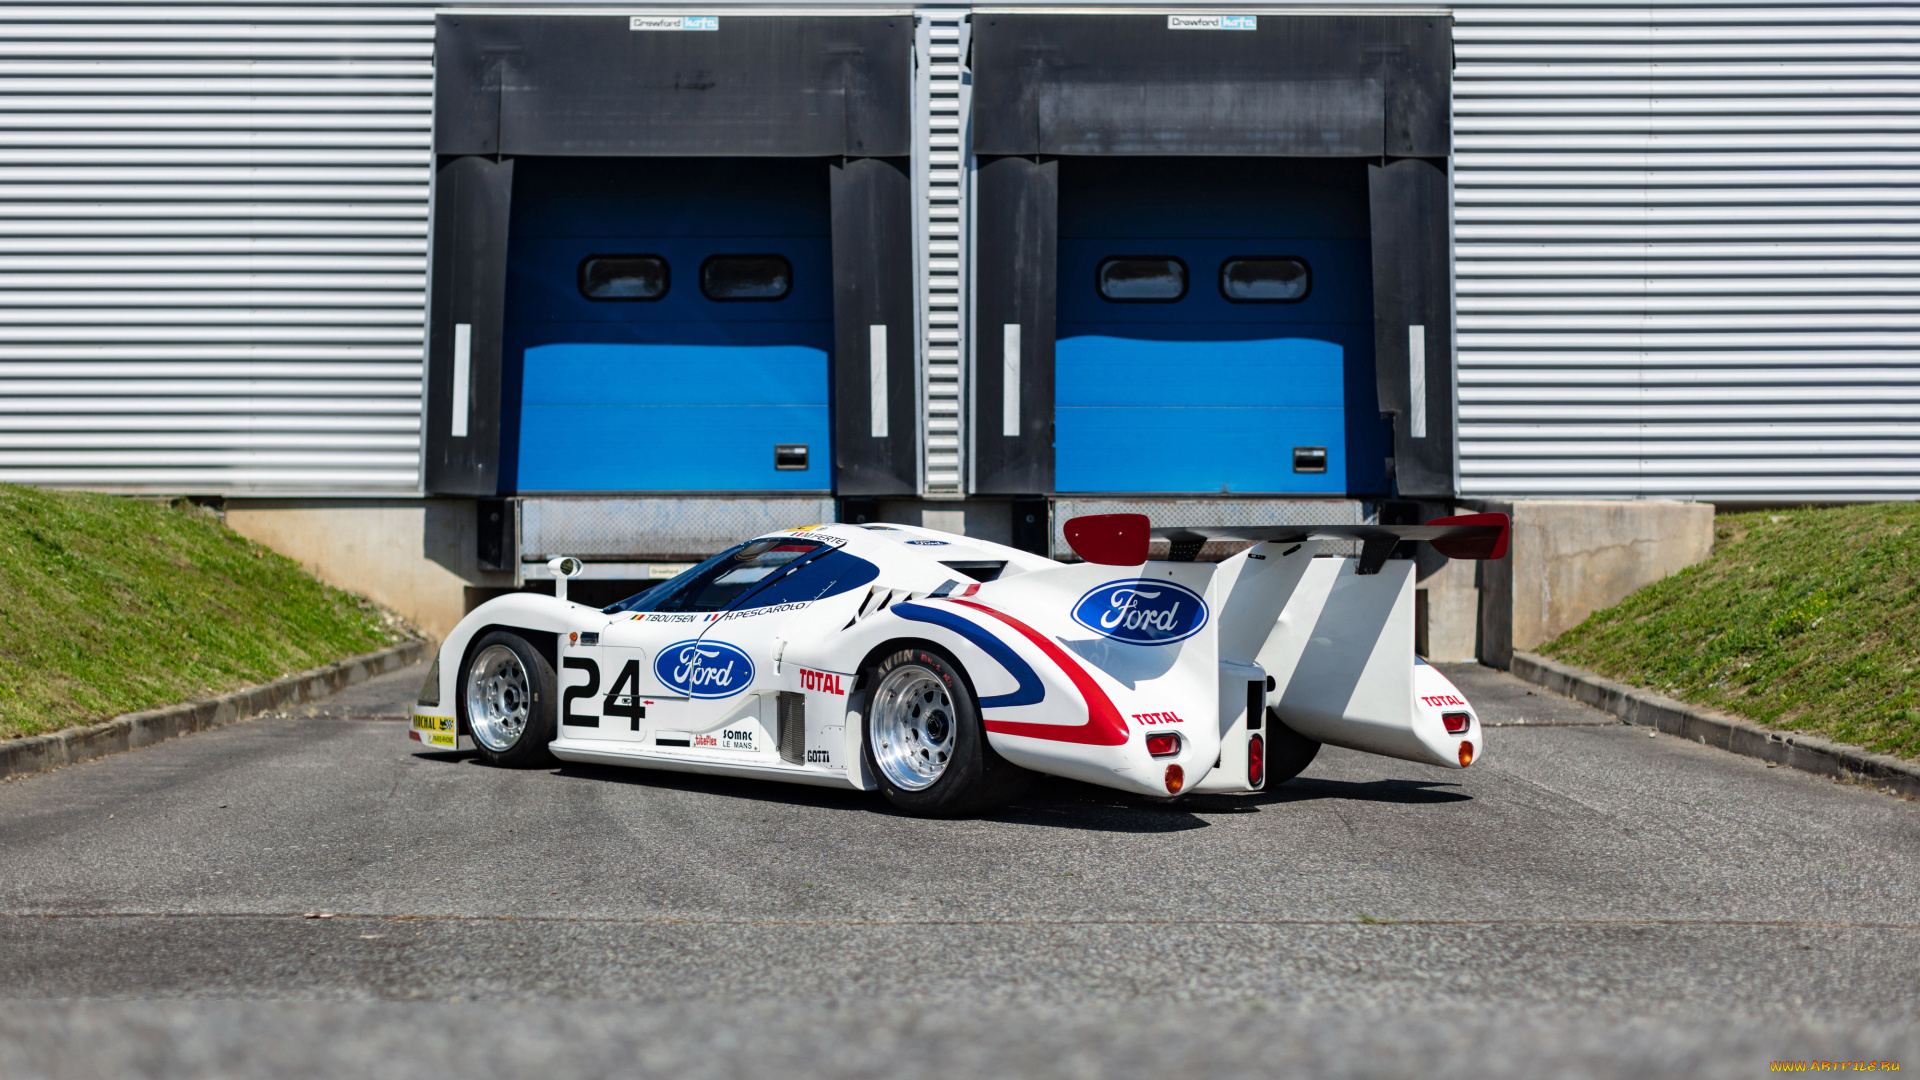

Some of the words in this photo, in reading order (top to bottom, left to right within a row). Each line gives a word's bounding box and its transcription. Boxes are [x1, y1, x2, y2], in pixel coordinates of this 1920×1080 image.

[1172, 17, 1219, 26] Crawford
[724, 602, 805, 621] H.PESCAROLO
[1100, 588, 1181, 631] Ford
[645, 614, 697, 623] T.BOUTSEN
[673, 646, 734, 687] Ford
[799, 668, 845, 696] TOTAL
[562, 656, 646, 732] 24
[1421, 695, 1465, 707] TOTAL
[1131, 711, 1184, 726] TOTAL
[723, 729, 753, 741] SOMAC
[722, 740, 731, 748] LE
[733, 741, 753, 749] MANS
